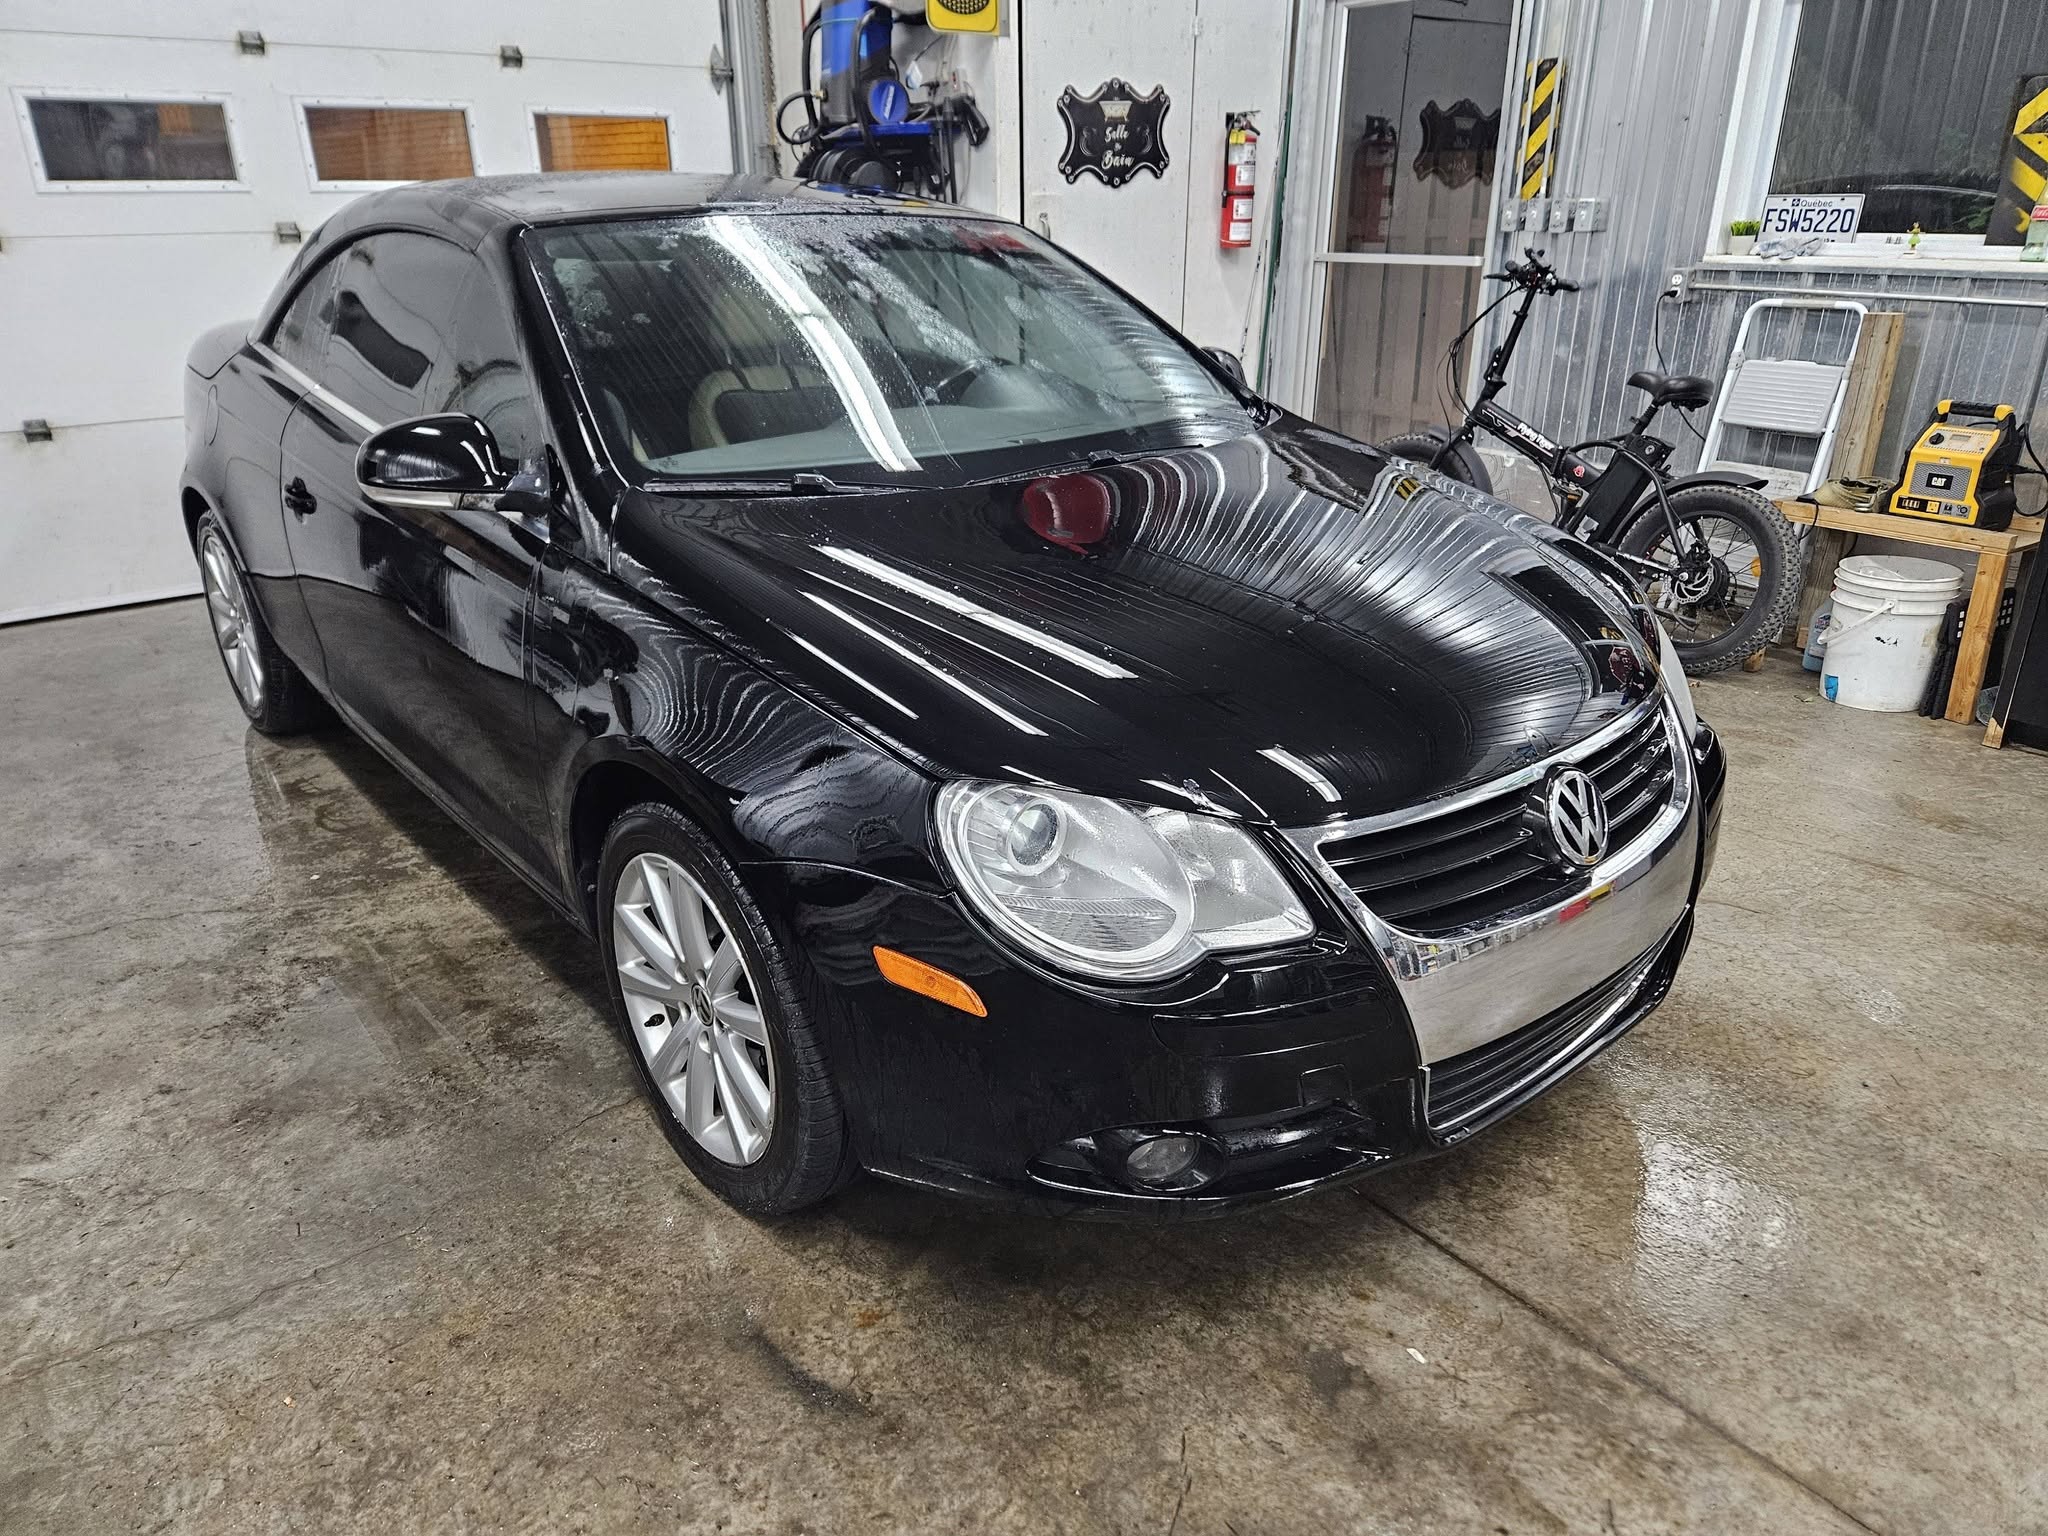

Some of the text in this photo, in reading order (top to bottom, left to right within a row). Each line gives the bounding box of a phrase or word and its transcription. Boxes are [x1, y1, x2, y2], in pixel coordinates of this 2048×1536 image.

[1105, 124, 1129, 143] Salle
[1101, 150, 1135, 169] Bain
[1762, 208, 1856, 233] FSW5220
[1931, 476, 1948, 487] CAT
